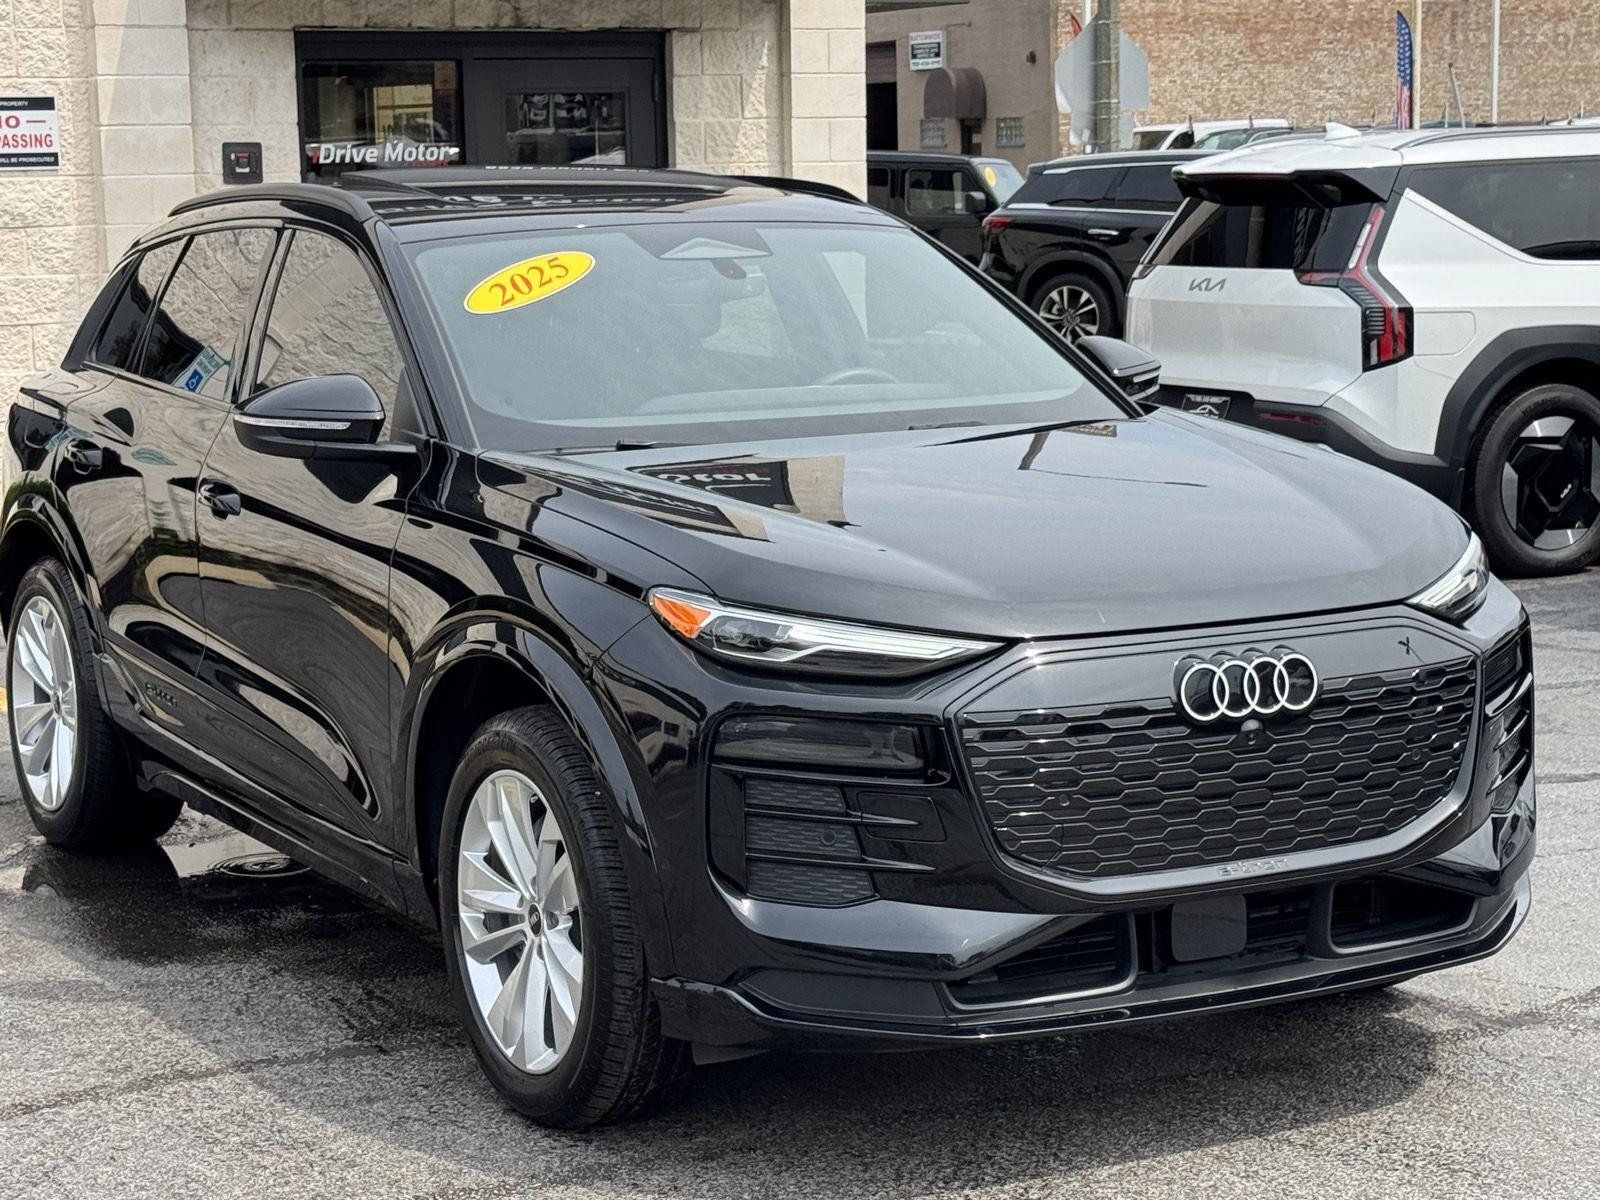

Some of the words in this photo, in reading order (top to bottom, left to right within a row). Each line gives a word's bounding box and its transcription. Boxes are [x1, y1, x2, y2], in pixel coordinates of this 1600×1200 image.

[0, 115, 21, 129] O
[0, 133, 53, 149] ASSING
[488, 257, 569, 306] 2025
